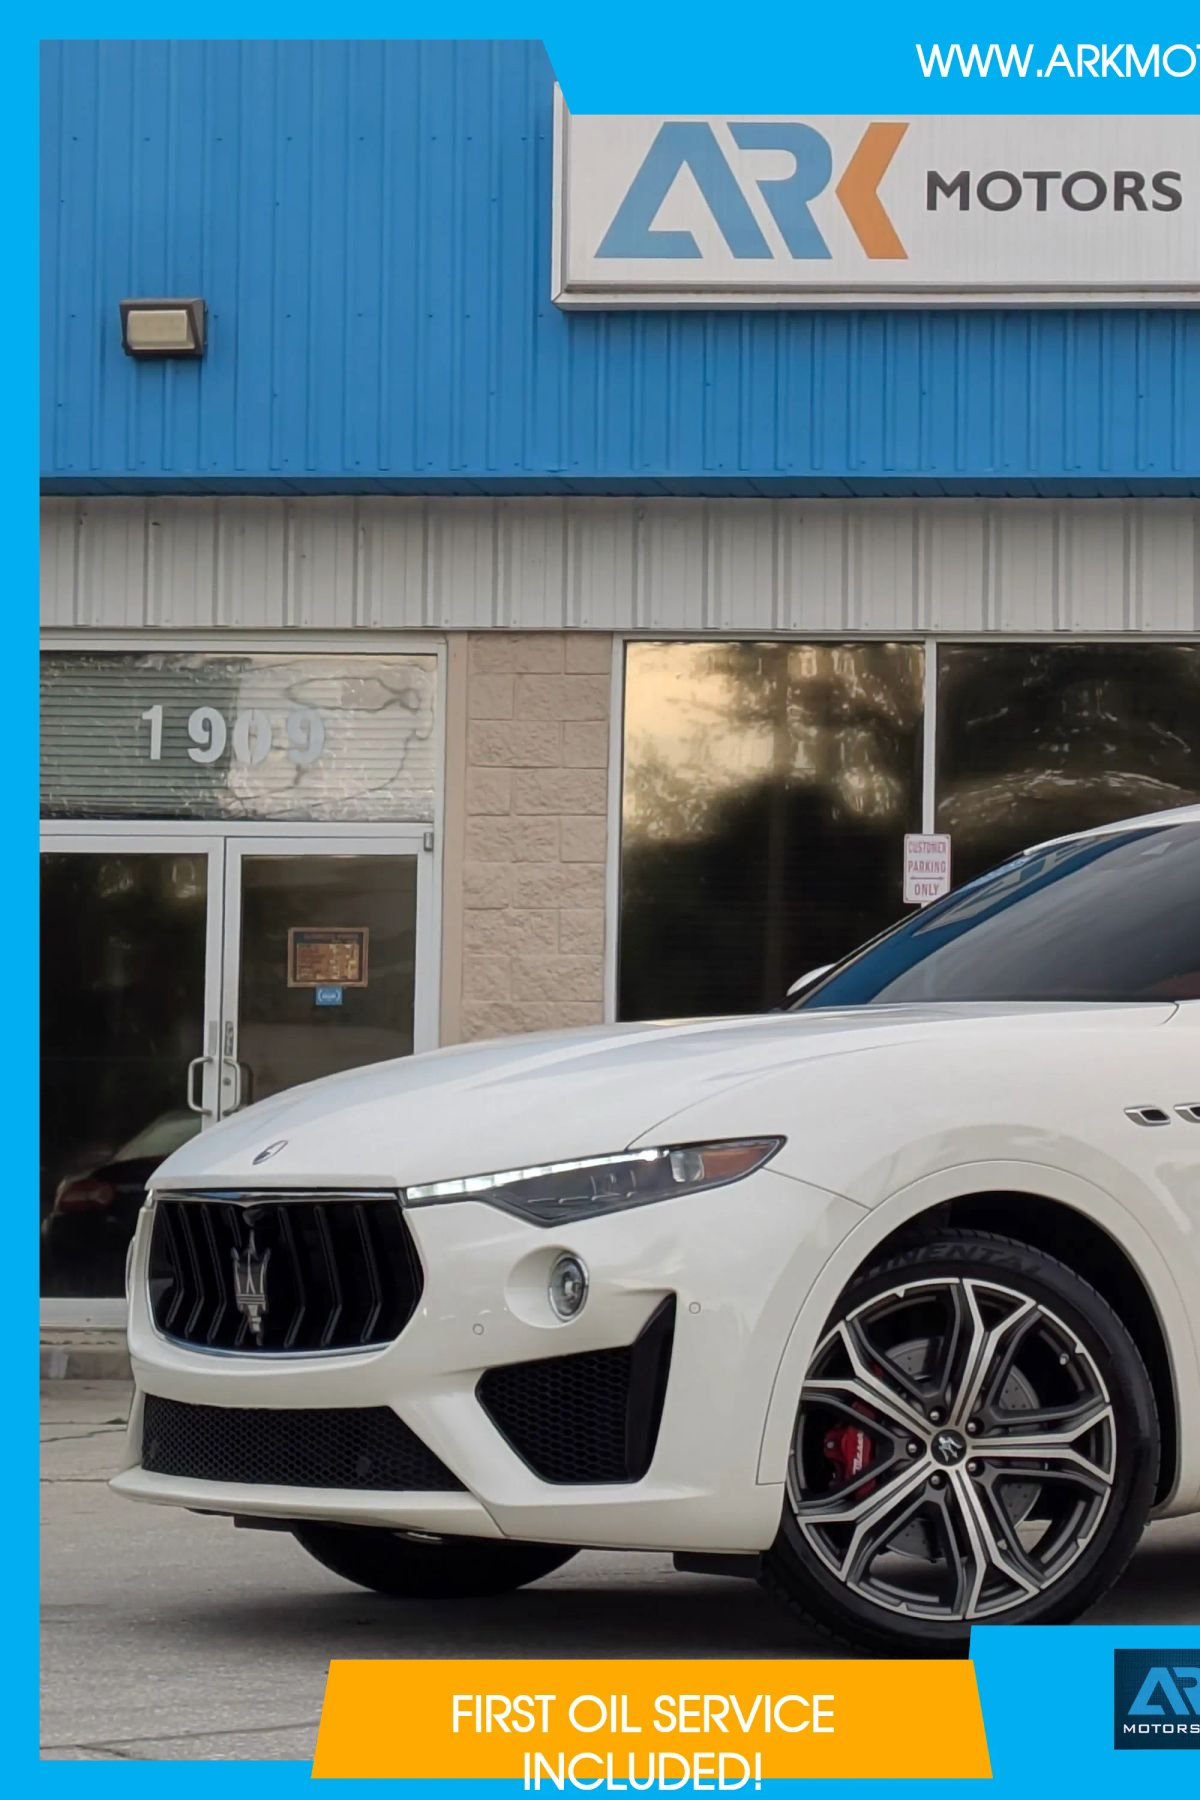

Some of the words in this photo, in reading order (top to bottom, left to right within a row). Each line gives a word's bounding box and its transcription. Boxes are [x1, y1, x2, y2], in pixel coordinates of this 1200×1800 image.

[593, 121, 910, 260] ARK
[925, 170, 1184, 212] MOTORS
[141, 704, 325, 765] 1909
[907, 860, 947, 873] PARKING
[914, 883, 940, 896] ONLY
